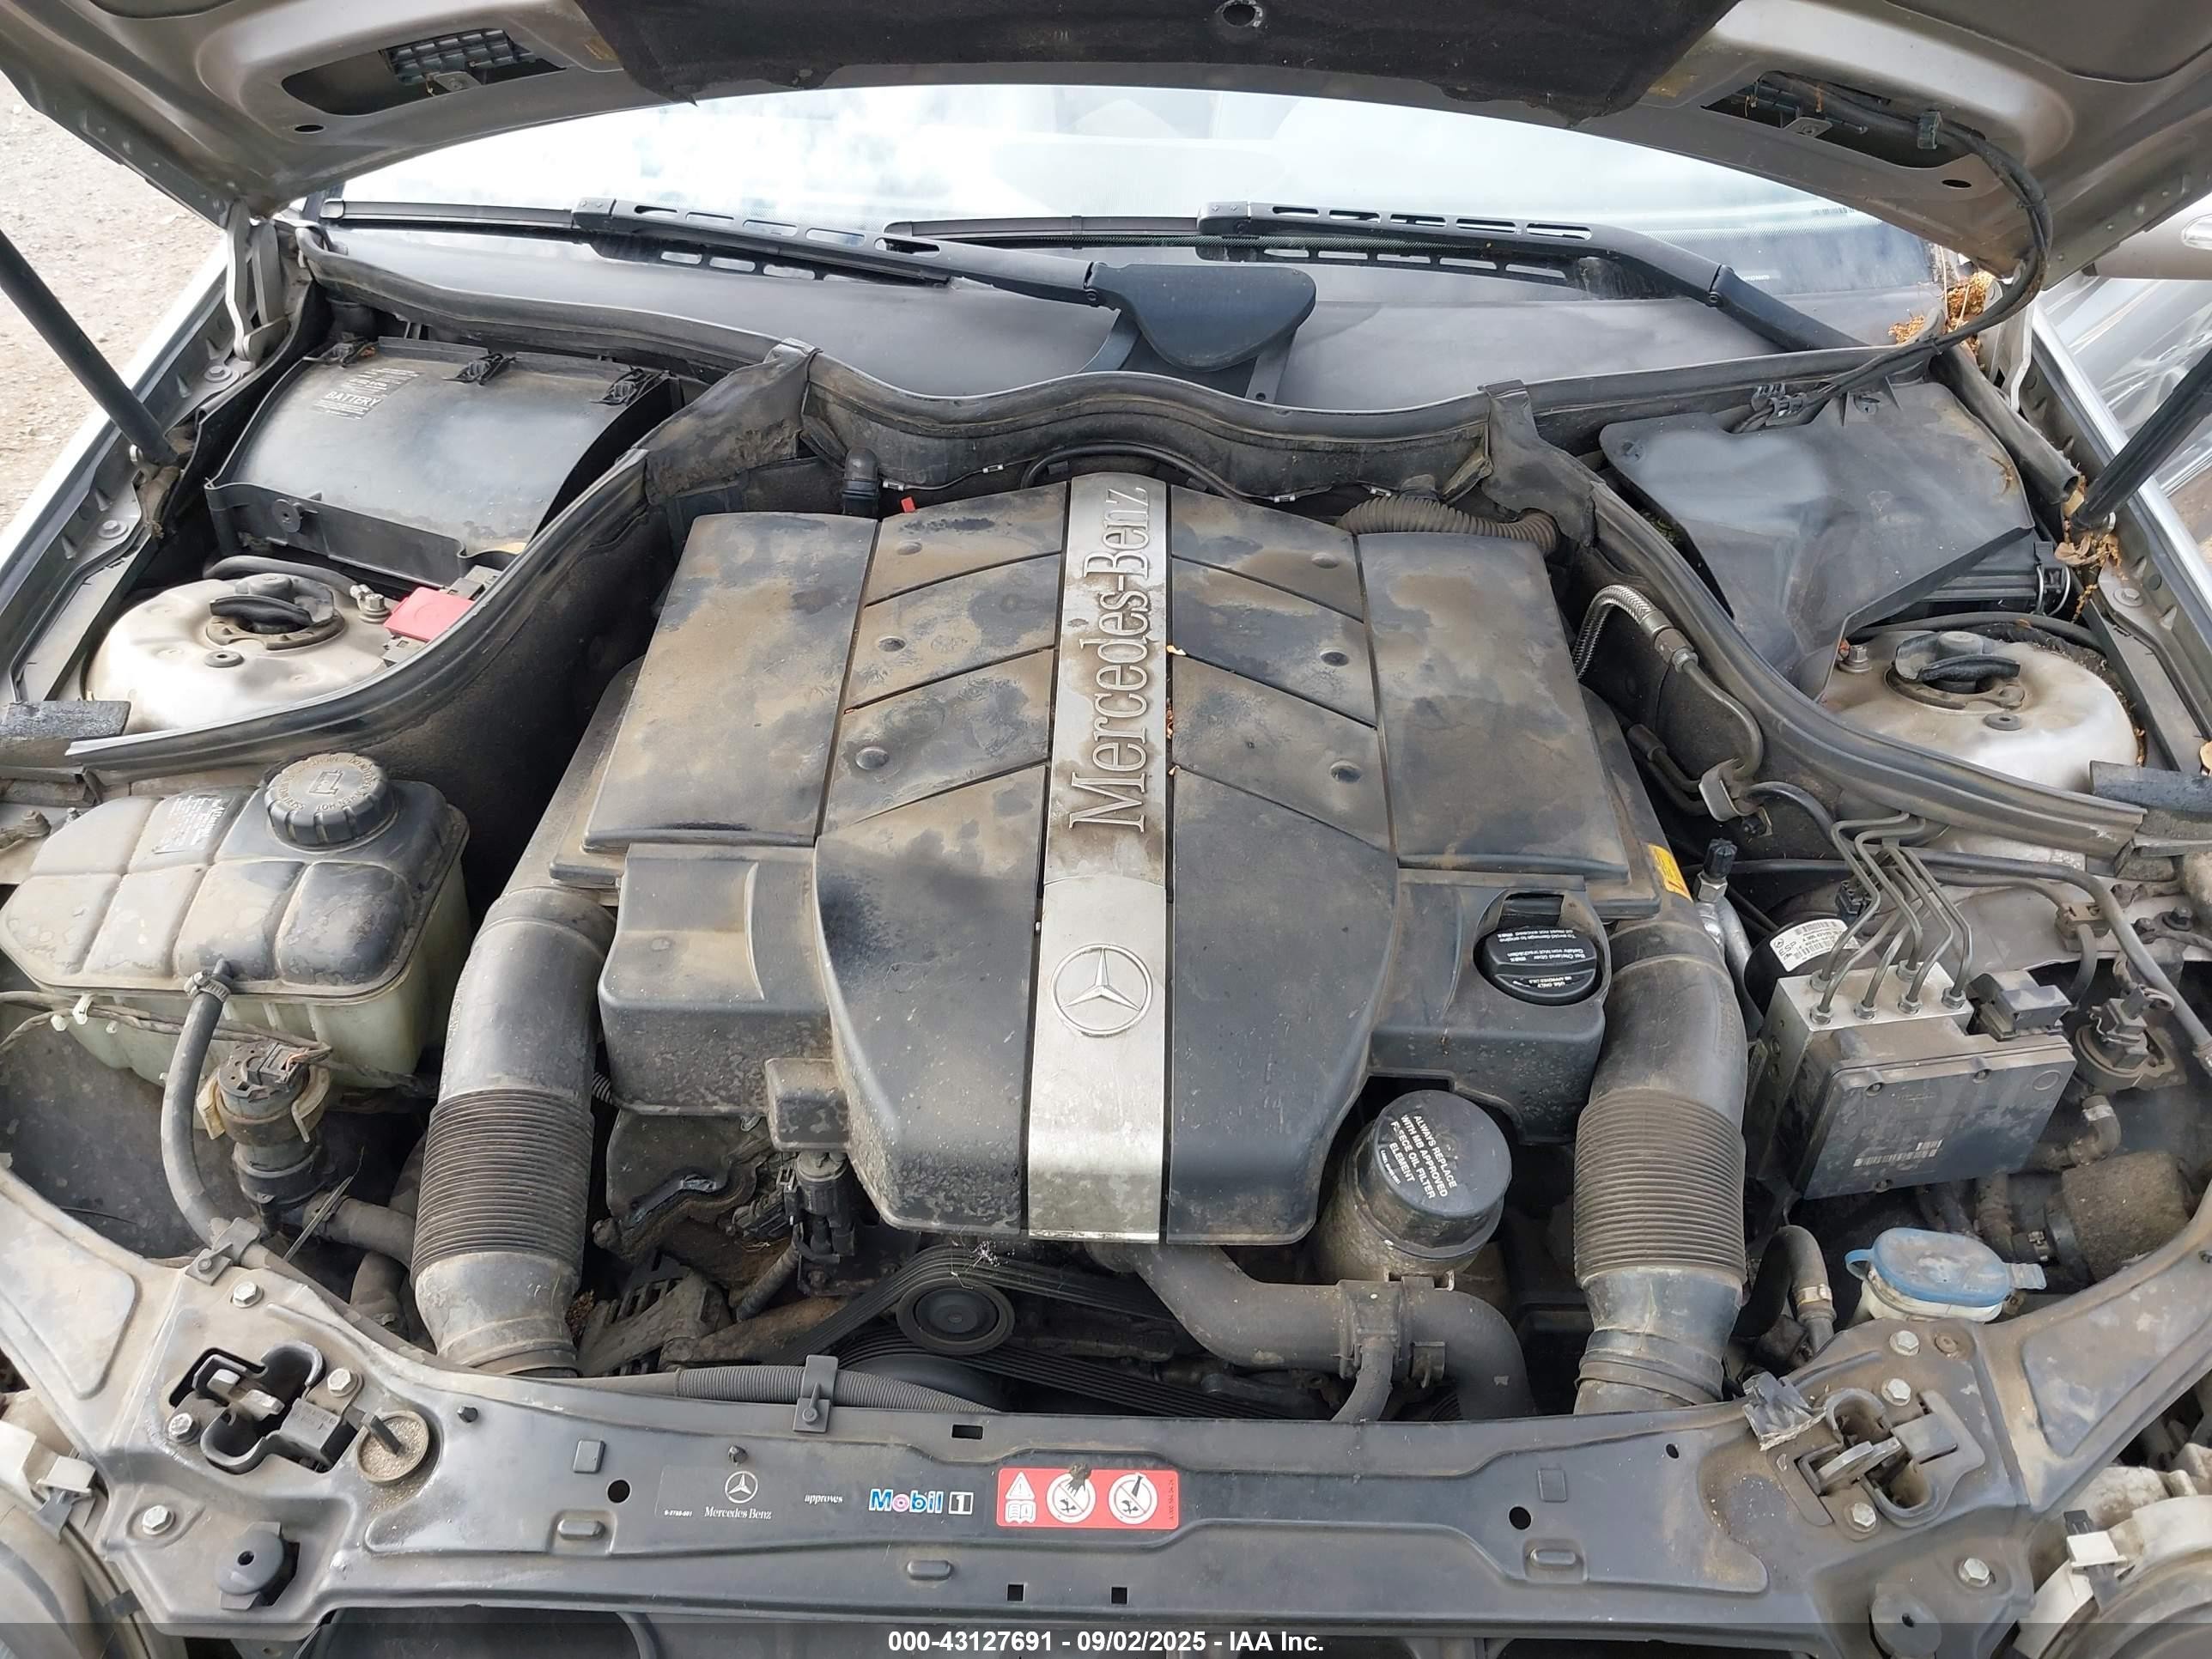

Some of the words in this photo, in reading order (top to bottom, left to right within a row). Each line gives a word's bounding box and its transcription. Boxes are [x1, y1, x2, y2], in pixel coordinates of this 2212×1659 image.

[325, 391, 381, 407] BATTERY
[1068, 486, 1151, 834] Mercedes-Benz
[316, 803, 337, 811] HOT
[1778, 941, 1796, 957] ESP
[1389, 1142, 1416, 1182] ELEMENT
[1401, 1115, 1418, 1135] WITH
[1413, 1134, 1425, 1149] MB
[1419, 1150, 1449, 1197] APPROVED
[1413, 1115, 1437, 1147] ALWAYS
[1431, 1146, 1457, 1188] REPLACE
[1408, 1152, 1420, 1168] OIL
[1416, 1168, 1436, 1199] FILTER
[805, 1493, 843, 1504] approves
[868, 1488, 944, 1514] Mobil
[704, 1506, 748, 1519] Mercedes
[748, 1508, 773, 1520] Benz
